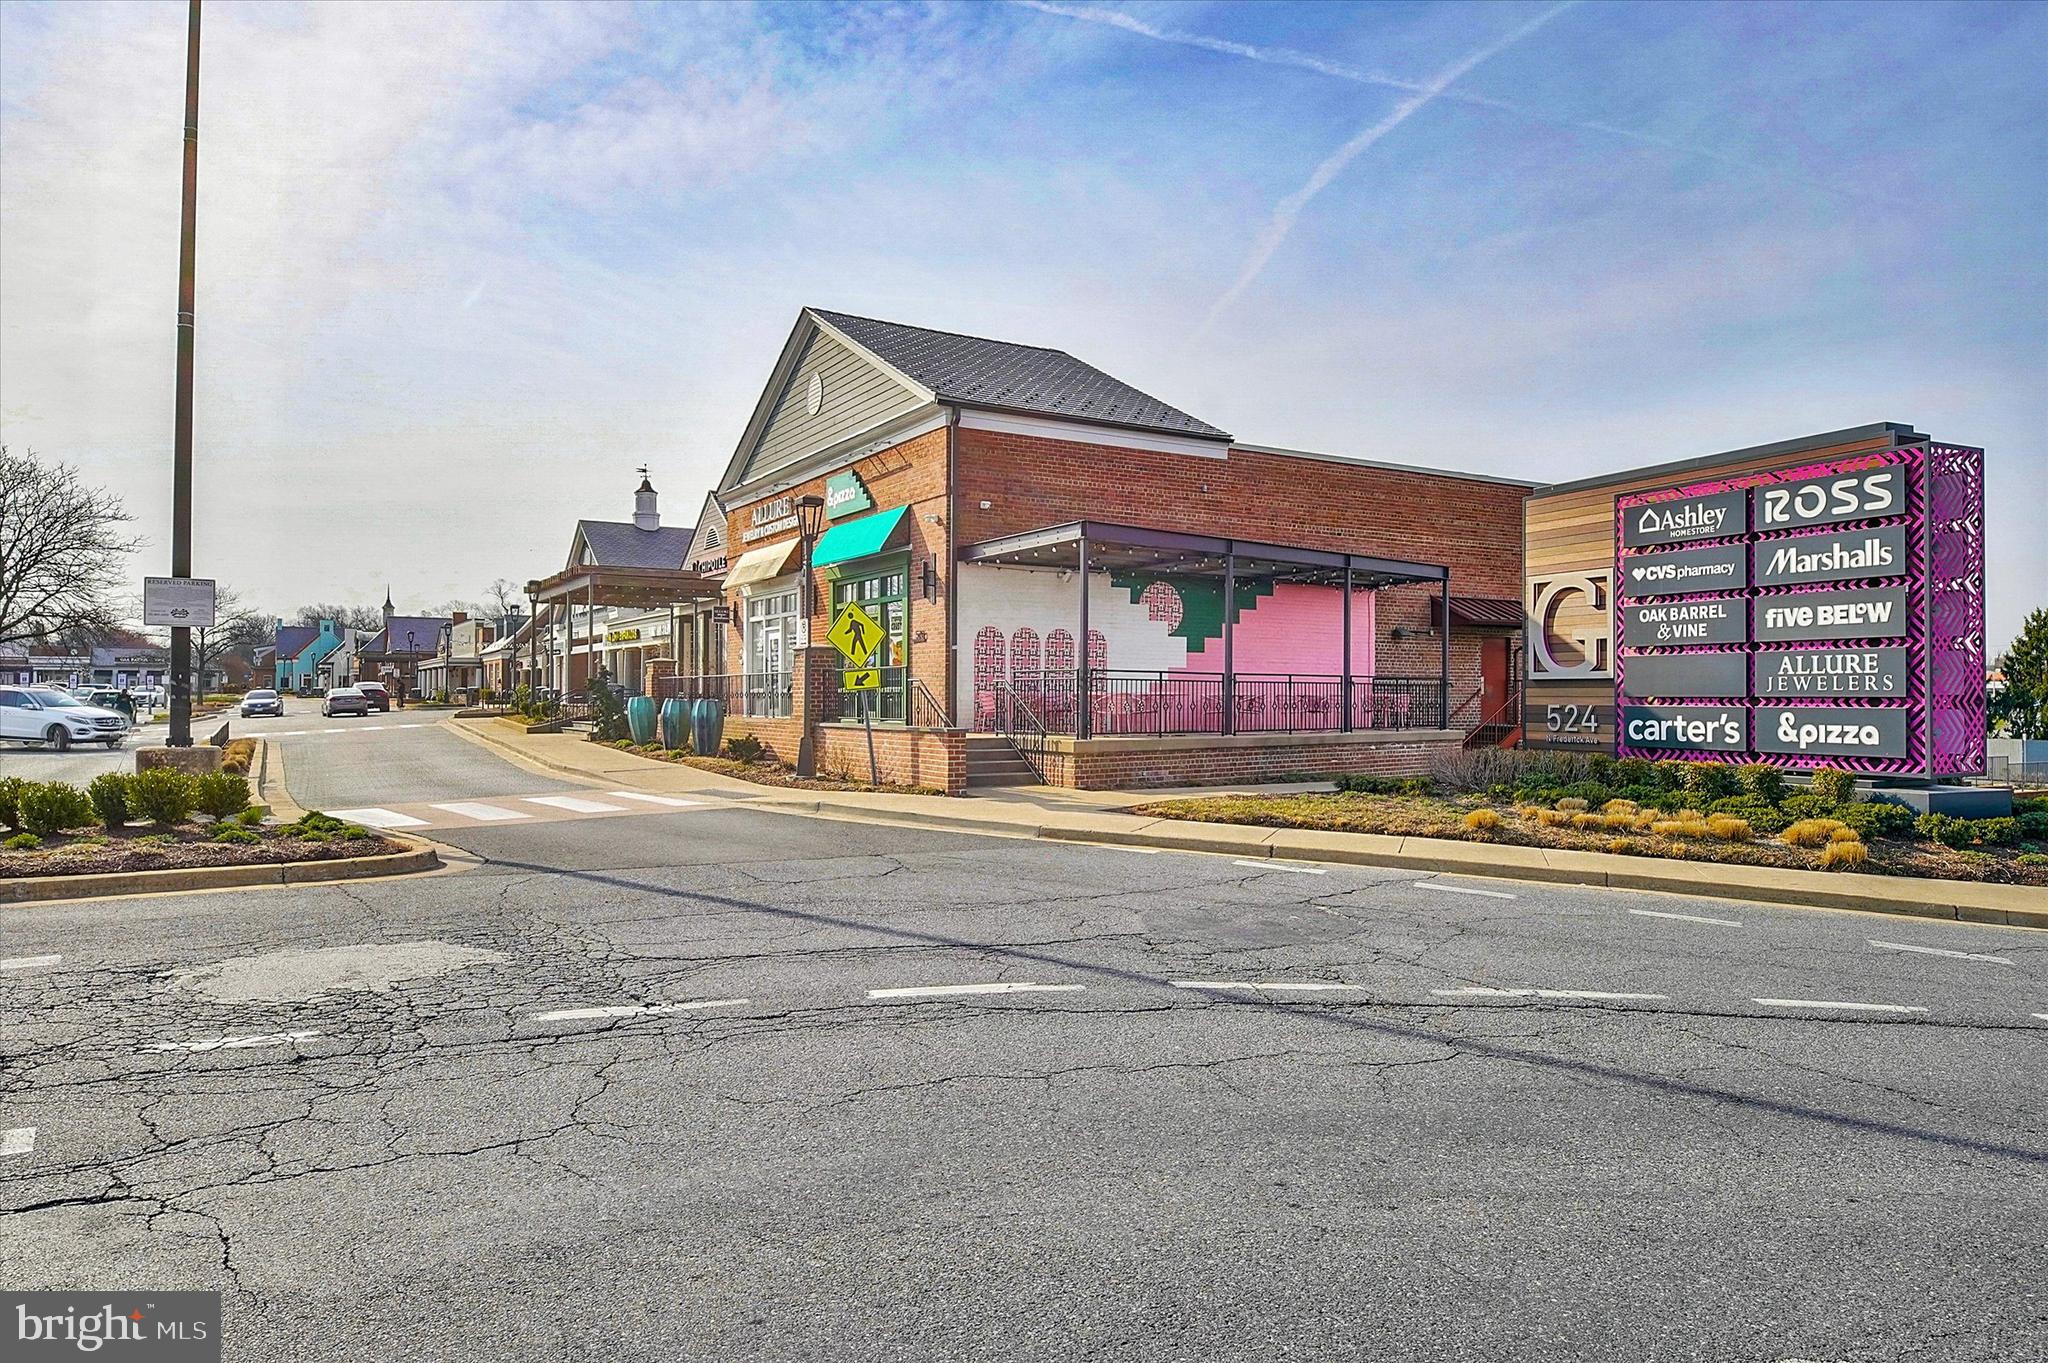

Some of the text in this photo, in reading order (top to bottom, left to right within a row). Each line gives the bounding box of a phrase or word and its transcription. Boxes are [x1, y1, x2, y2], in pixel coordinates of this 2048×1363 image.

[1764, 473, 1892, 523] ROSS
[751, 496, 790, 527] ALLURE
[1661, 503, 1727, 530] Ashley
[1670, 525, 1715, 538] HOMESTORE
[1765, 538, 1893, 576] Marshalls
[1646, 563, 1735, 581] CVS pharmacy
[1640, 604, 1727, 623] OAK BARREL
[1765, 606, 1813, 628] five
[1657, 622, 1708, 641] & VINE
[1778, 653, 1879, 675] ALLURE
[1766, 674, 1894, 693] JEWELERS
[1546, 703, 1599, 733] 524
[1628, 713, 1741, 744] carter's
[1777, 712, 1880, 749] &pizza
